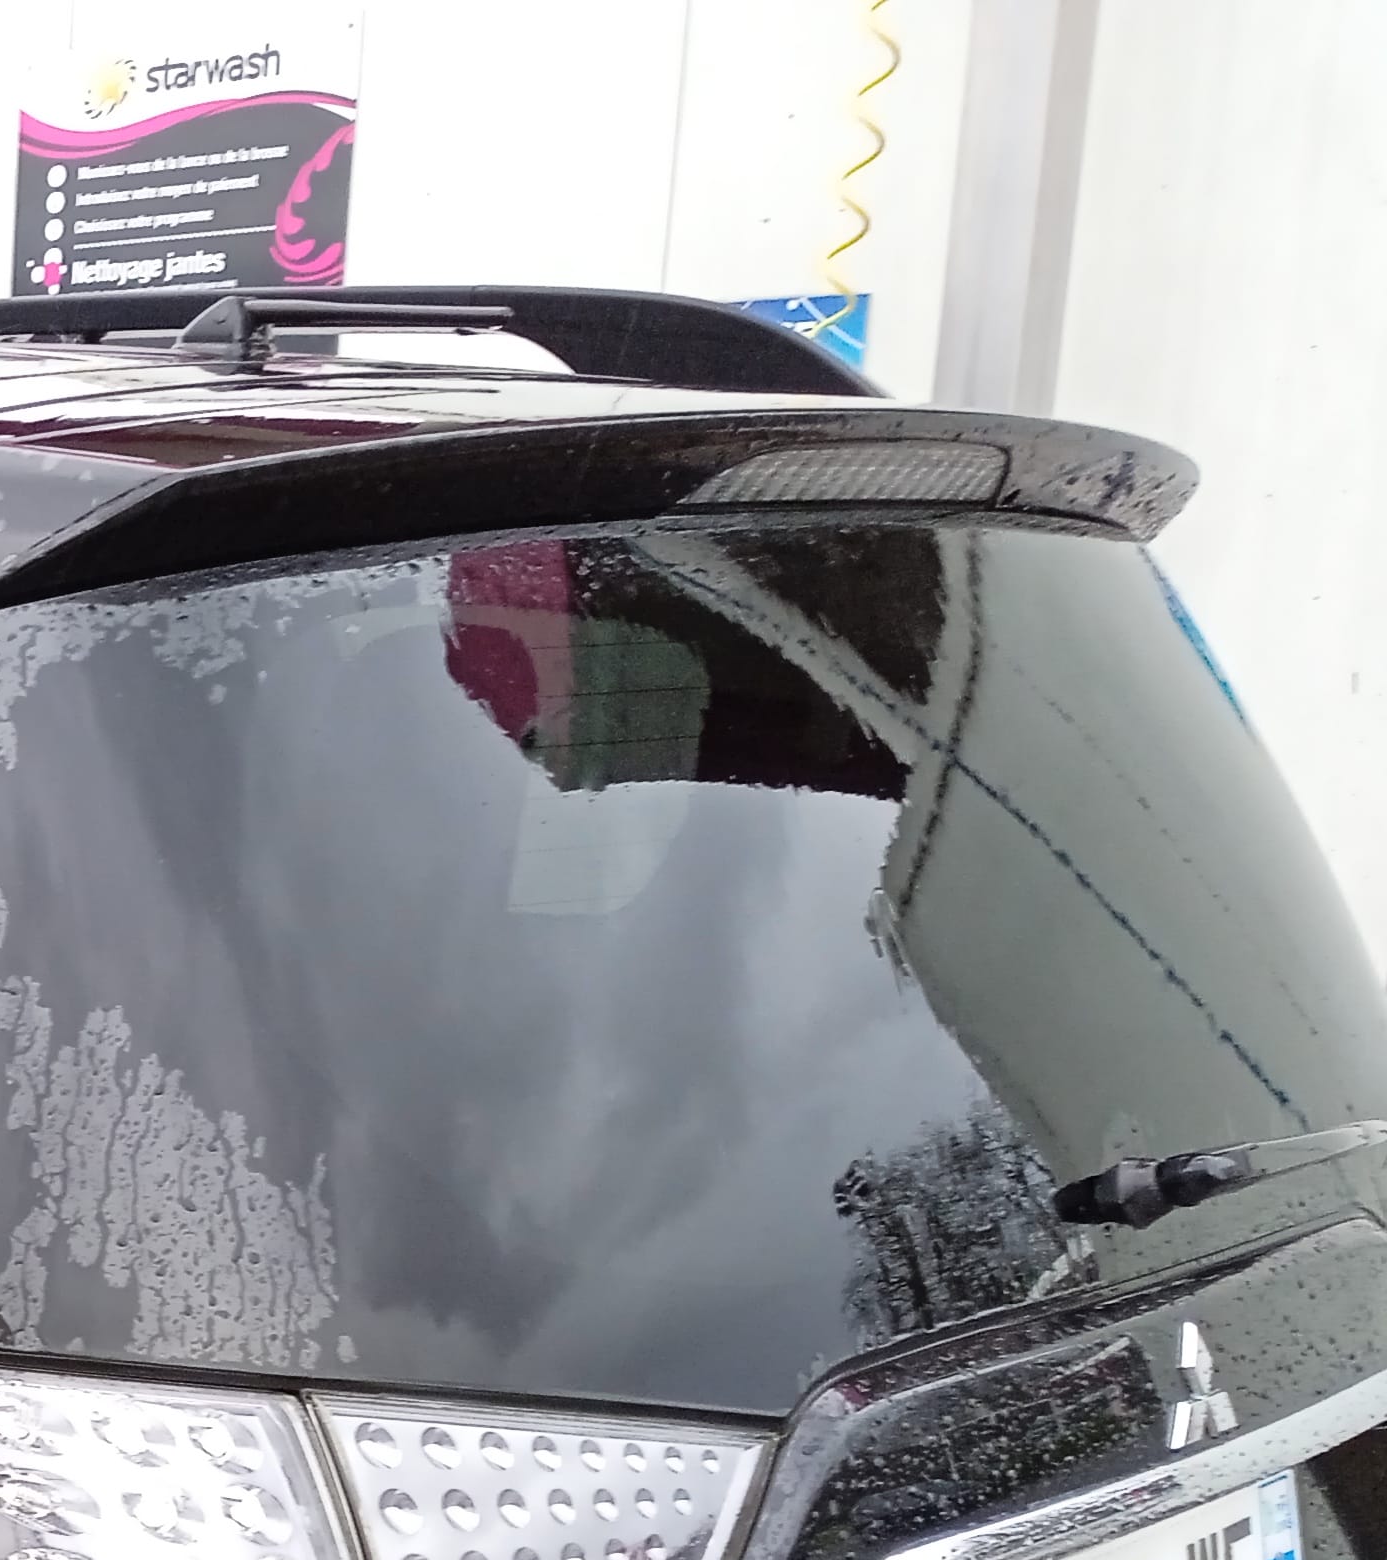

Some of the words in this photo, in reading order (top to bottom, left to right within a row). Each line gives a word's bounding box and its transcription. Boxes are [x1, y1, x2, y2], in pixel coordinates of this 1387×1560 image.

[145, 43, 280, 92] starwash
[71, 257, 164, 286] Nettoyage
[164, 250, 227, 282] jantes
